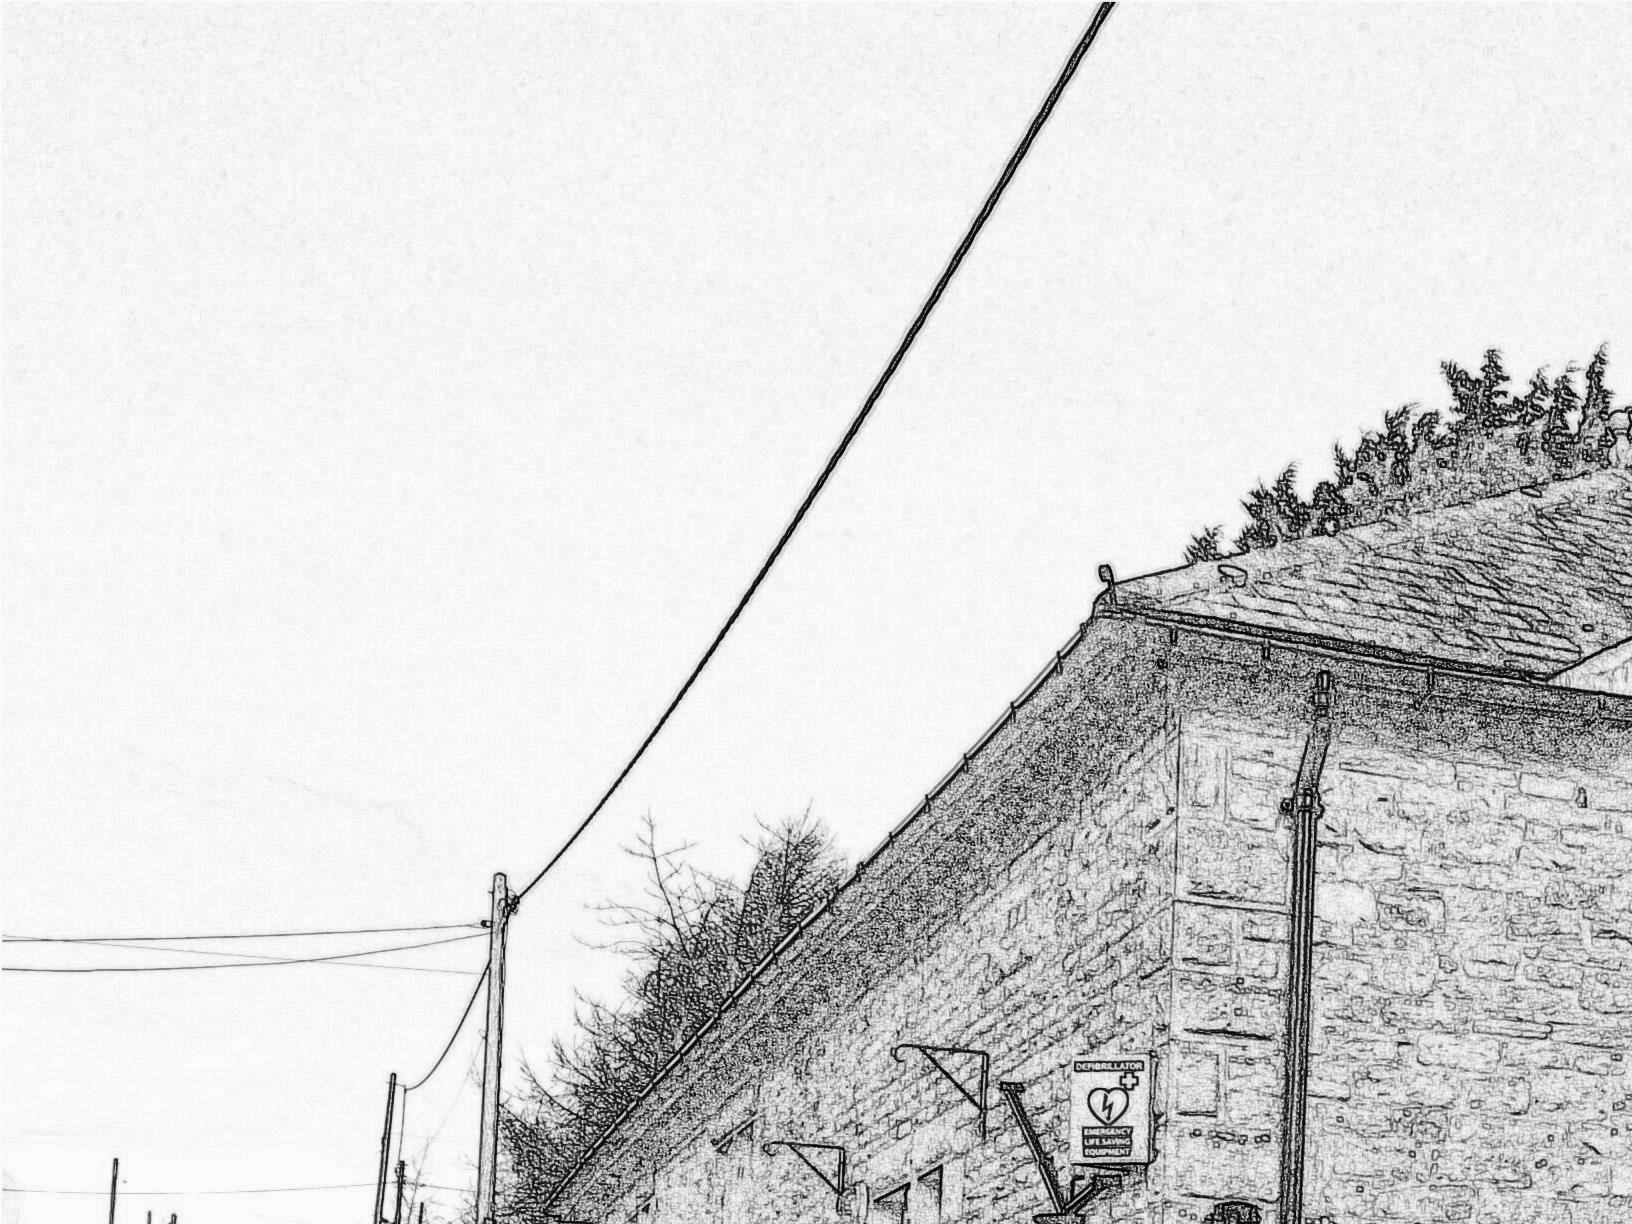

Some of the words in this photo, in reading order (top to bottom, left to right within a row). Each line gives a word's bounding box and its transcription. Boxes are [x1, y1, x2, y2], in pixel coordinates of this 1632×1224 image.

[1076, 1062, 1143, 1070] DEFIBRILLATOR
[1084, 1138, 1101, 1146] LIFE
[1102, 1138, 1131, 1146] SAVING
[1084, 1148, 1131, 1156] EQUIPMENT
